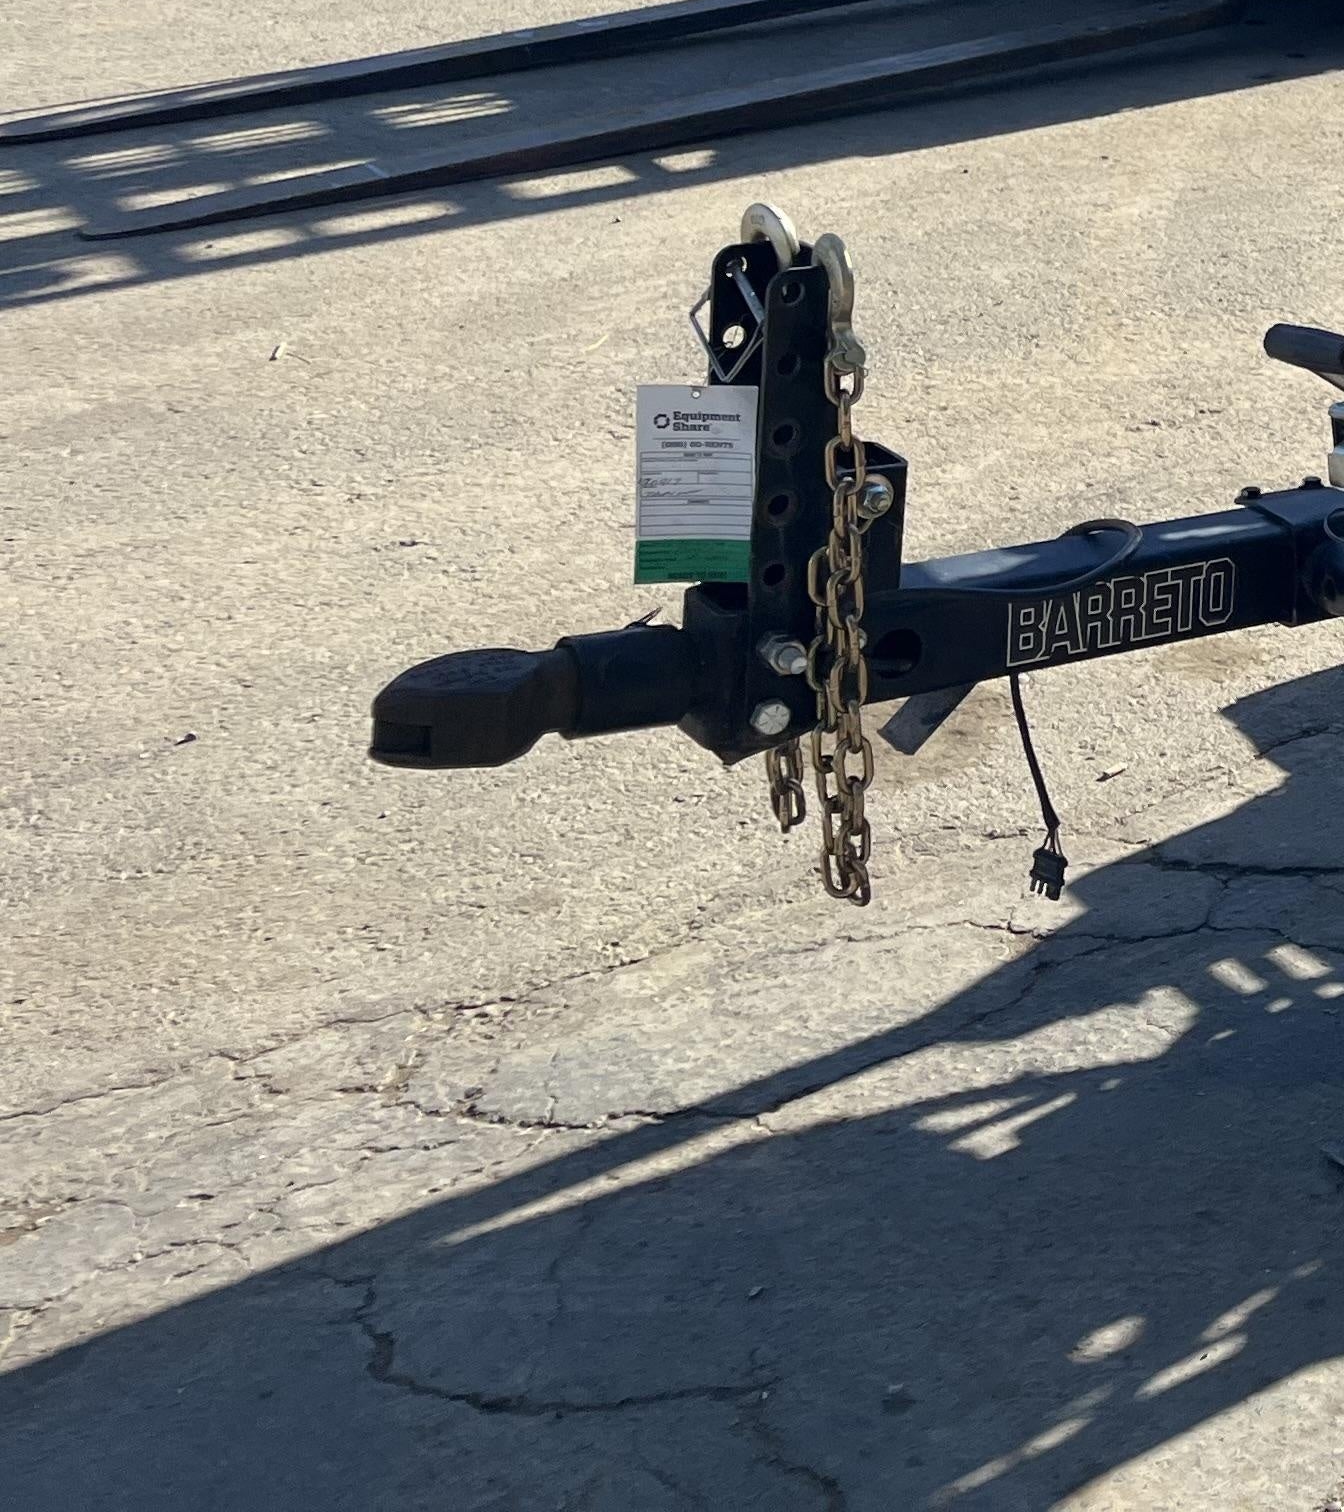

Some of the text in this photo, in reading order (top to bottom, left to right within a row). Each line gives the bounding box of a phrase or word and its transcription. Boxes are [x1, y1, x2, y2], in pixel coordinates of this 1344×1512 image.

[672, 410, 741, 423] Equipment
[672, 421, 712, 432] Share
[1006, 556, 1236, 668] BARRETO
